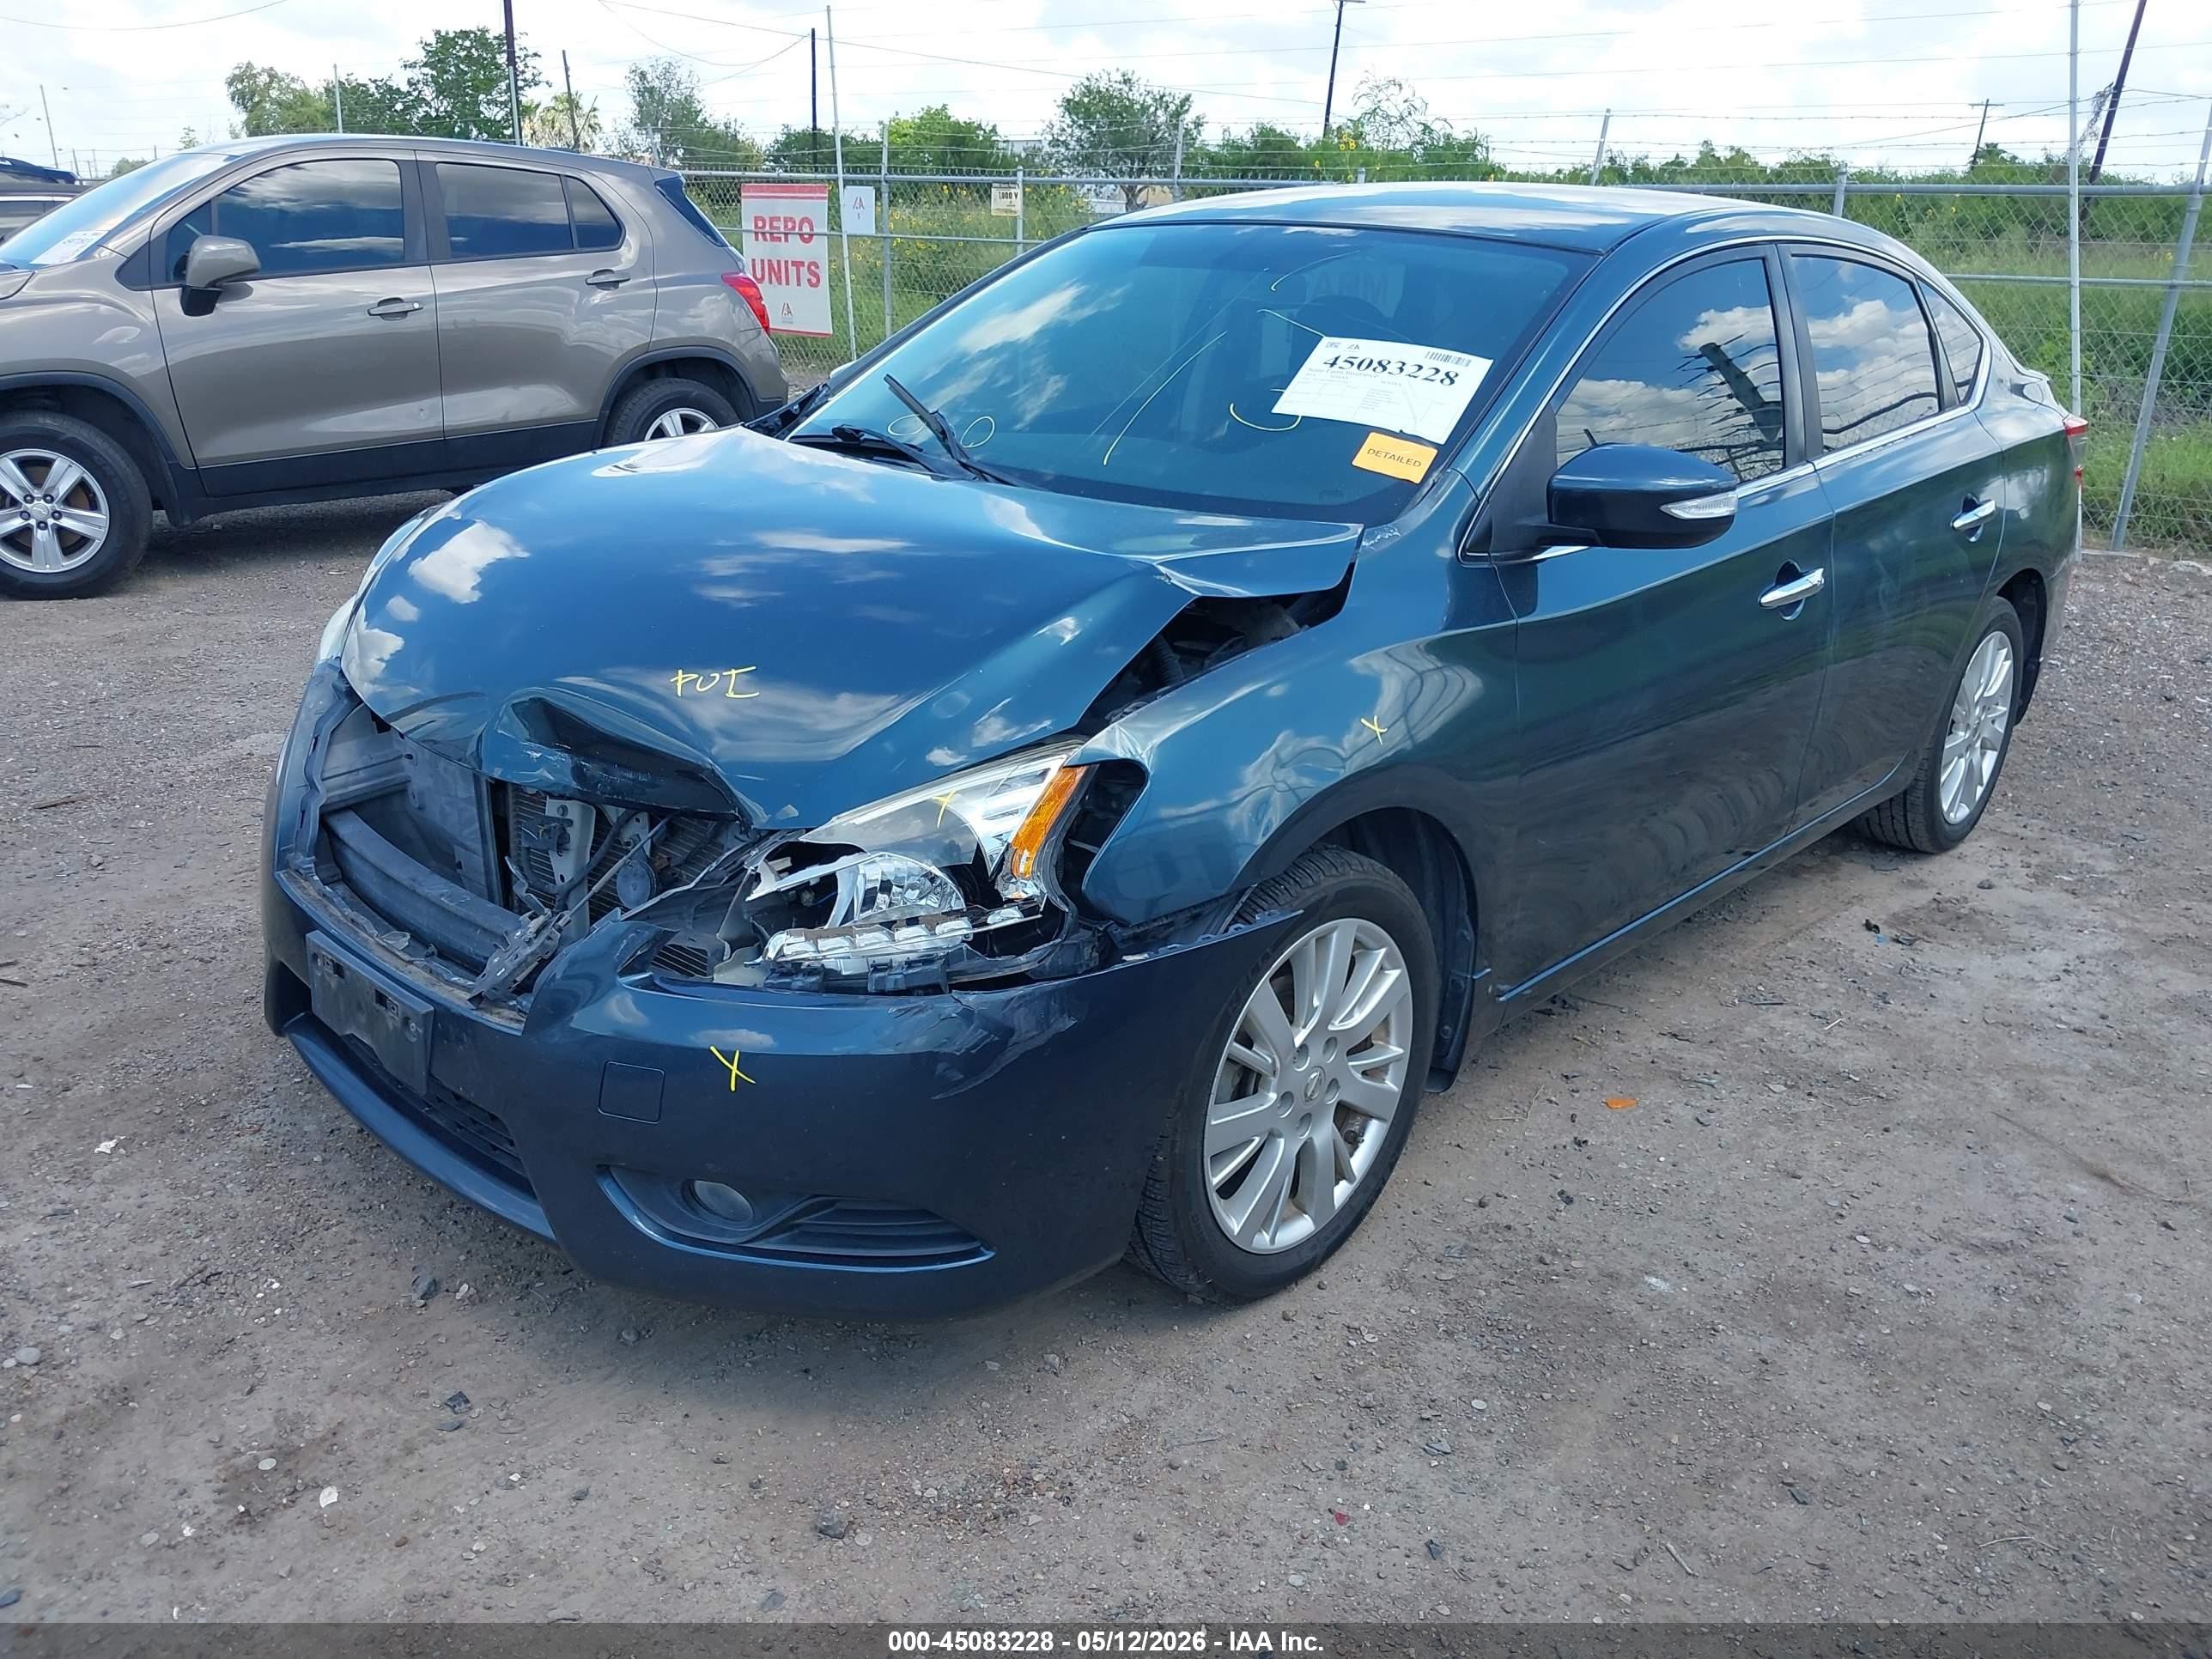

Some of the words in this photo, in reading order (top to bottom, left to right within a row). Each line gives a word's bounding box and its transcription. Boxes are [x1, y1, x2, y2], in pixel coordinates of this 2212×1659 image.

[754, 216, 814, 244] REPO
[751, 258, 821, 288] UNITS
[1322, 355, 1460, 386] 45083228
[1366, 448, 1422, 467] DETAILED
